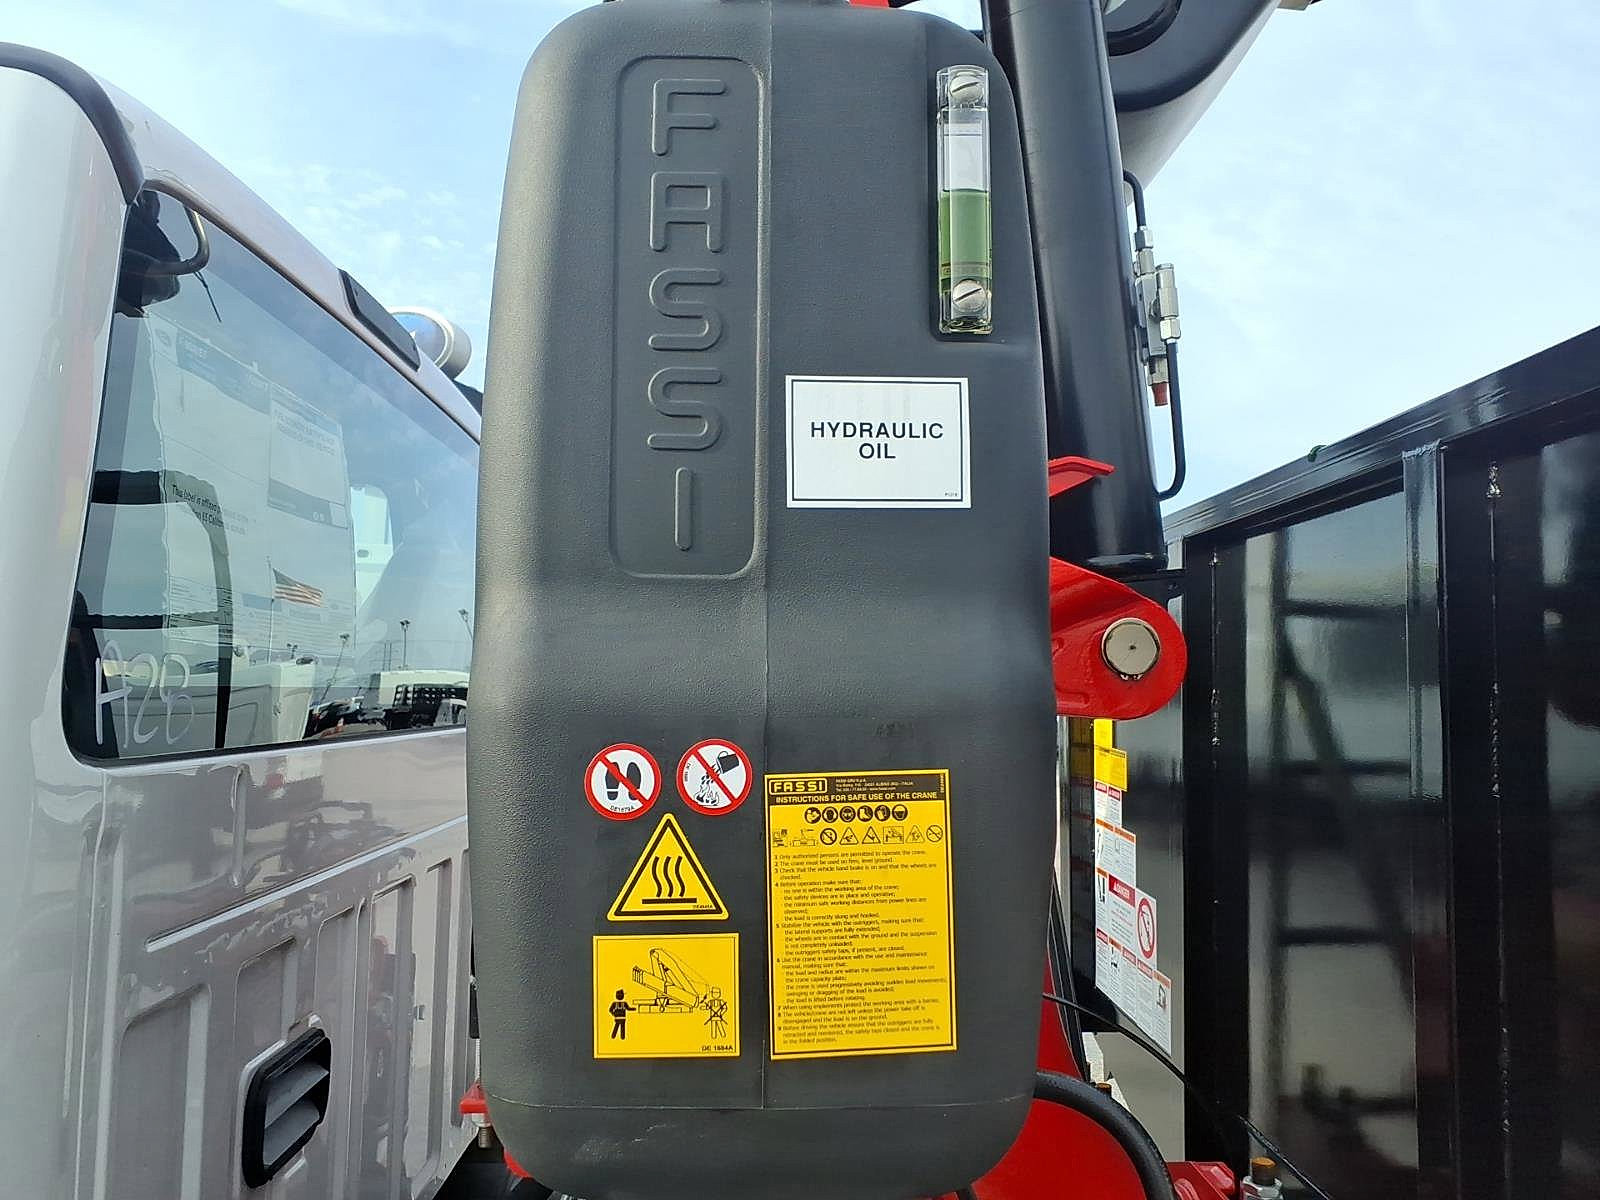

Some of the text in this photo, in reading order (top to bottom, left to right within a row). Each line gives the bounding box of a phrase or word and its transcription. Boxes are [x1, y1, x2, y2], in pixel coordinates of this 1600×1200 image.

[648, 78, 727, 552] FASSI
[811, 421, 944, 439] HYDRAULIC
[858, 443, 896, 459] OIL
[773, 780, 823, 792] FASSI
[776, 795, 829, 804] INSTRUCTIONS
[847, 793, 867, 801] SAFE
[911, 791, 937, 799] CRANE
